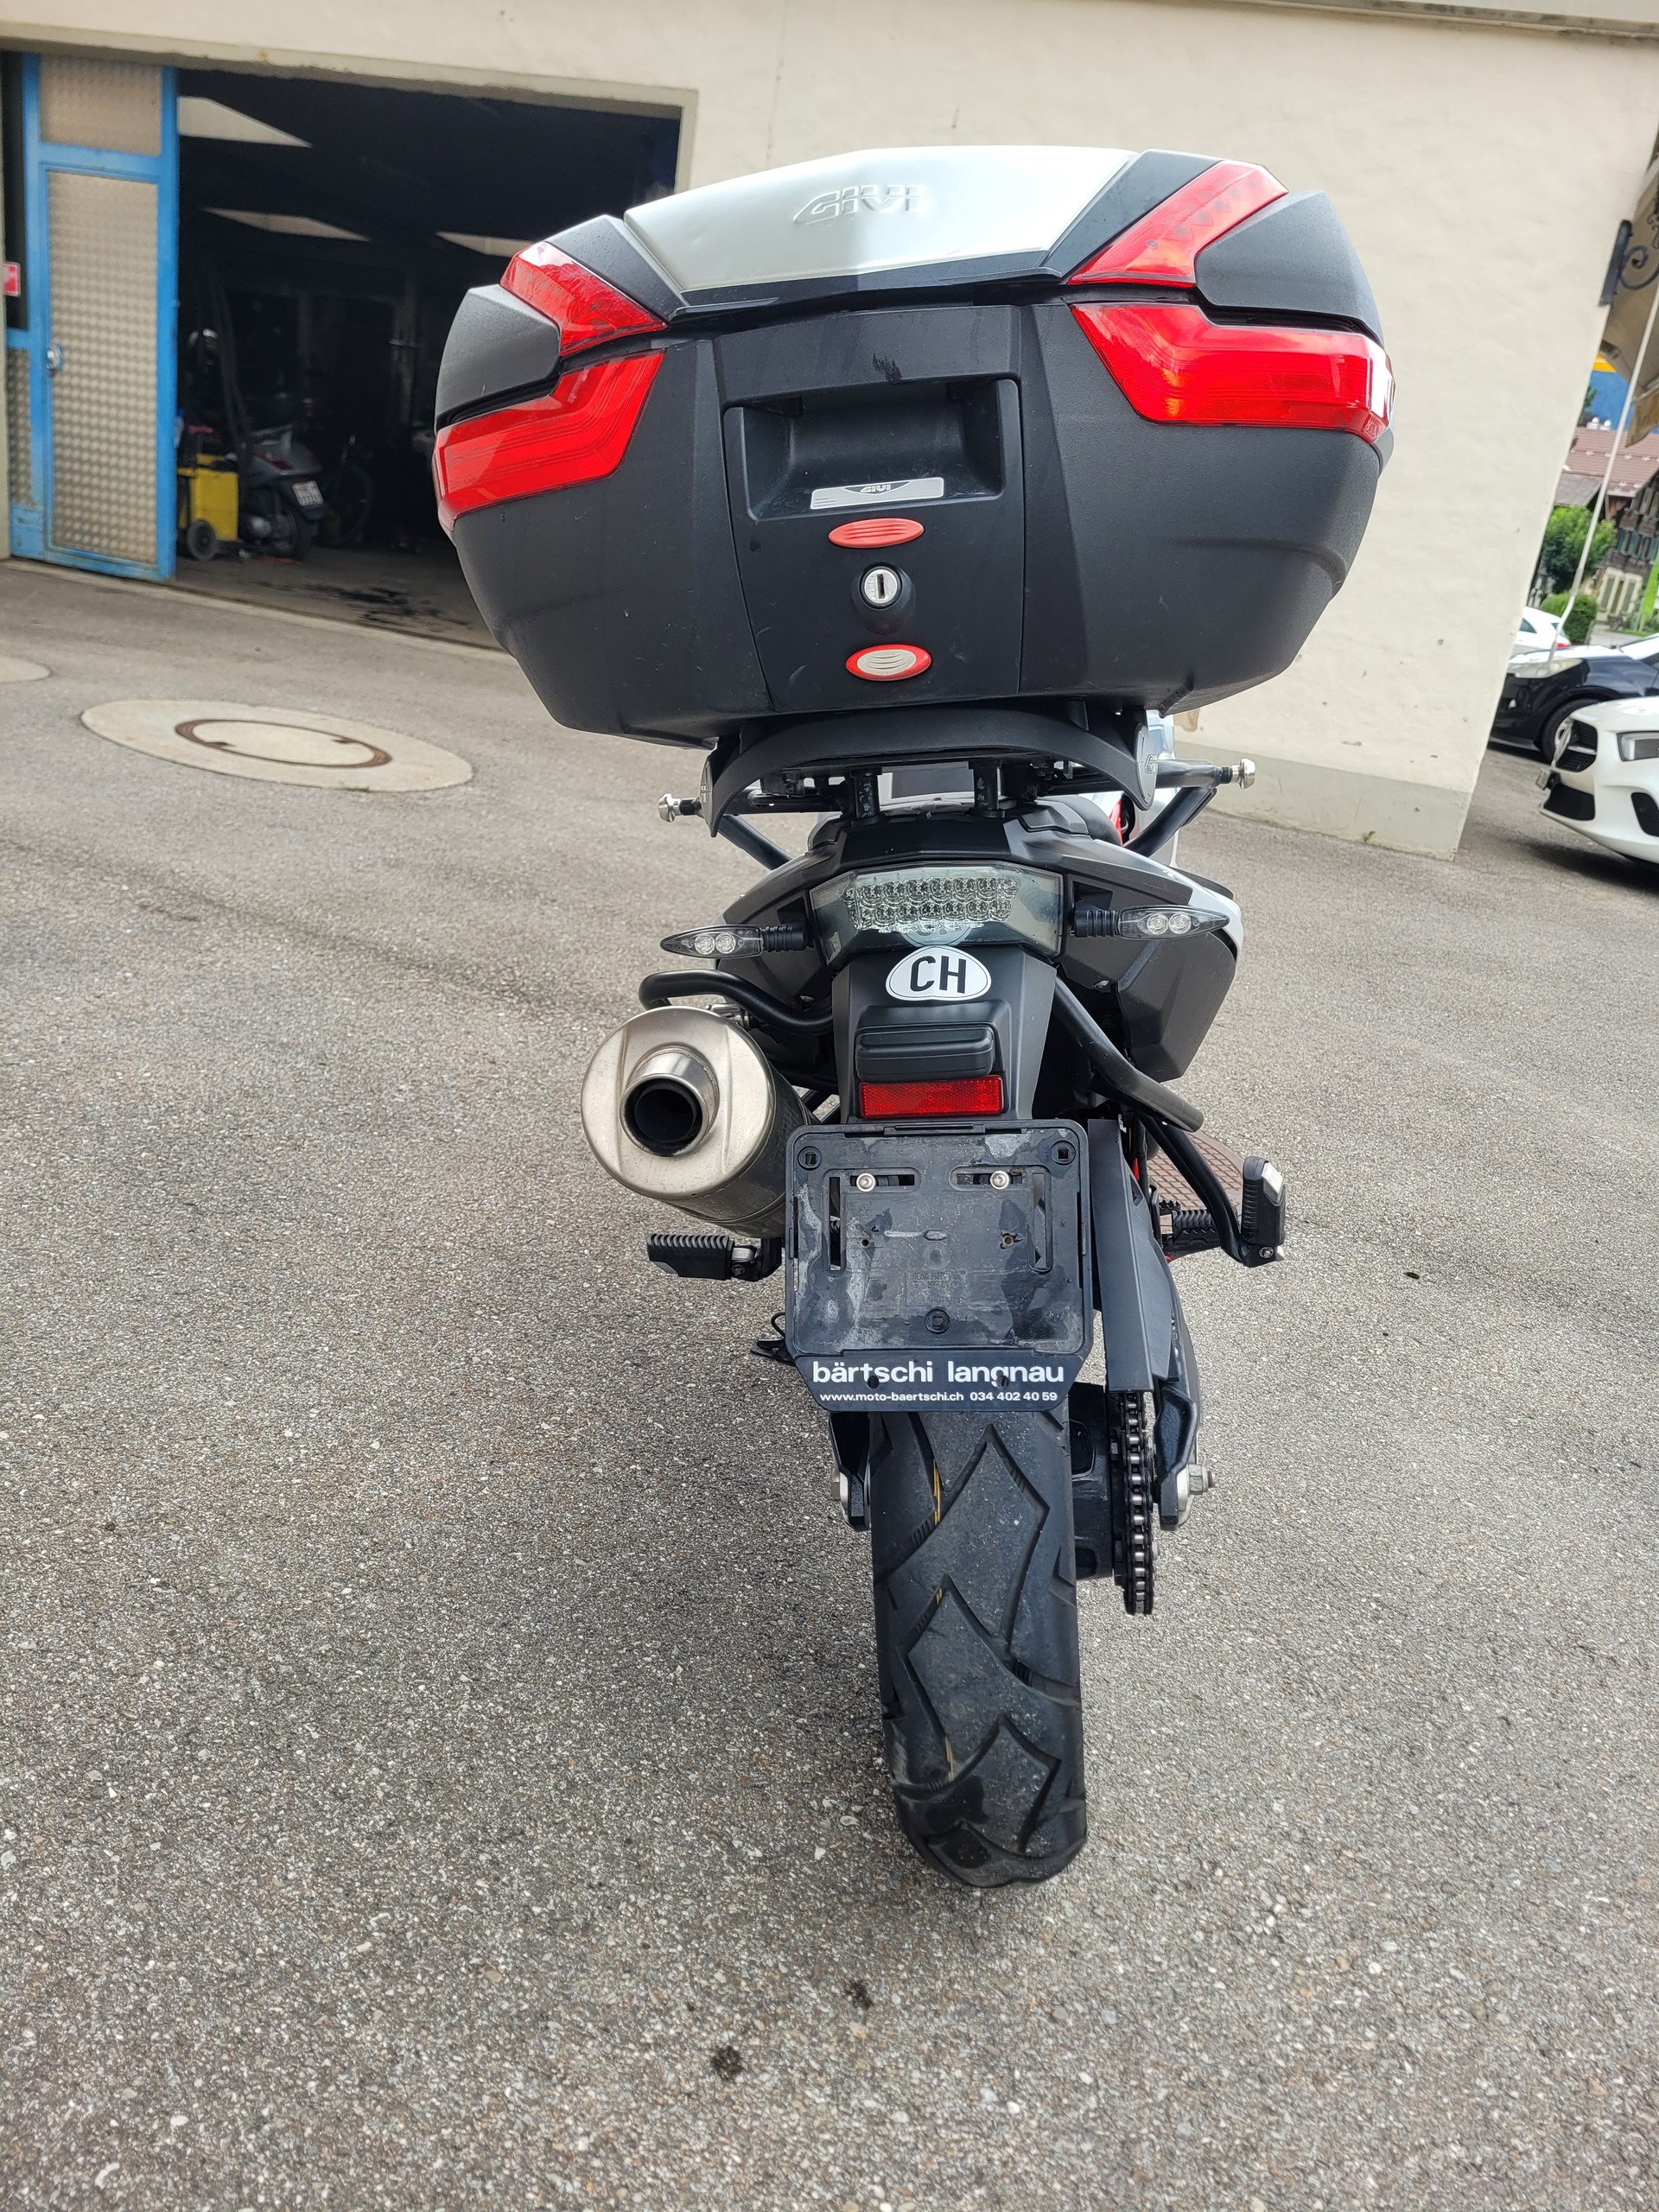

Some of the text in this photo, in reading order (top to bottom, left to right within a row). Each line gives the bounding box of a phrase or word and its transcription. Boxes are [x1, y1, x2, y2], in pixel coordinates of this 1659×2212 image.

[793, 185, 925, 224] GIVI
[860, 484, 892, 493] GIVI
[910, 955, 967, 995] CH
[812, 1360, 1065, 1388] bärtschi langnau
[819, 1391, 1058, 1402] www.moto-baertschi.ch 034 402 40 59
